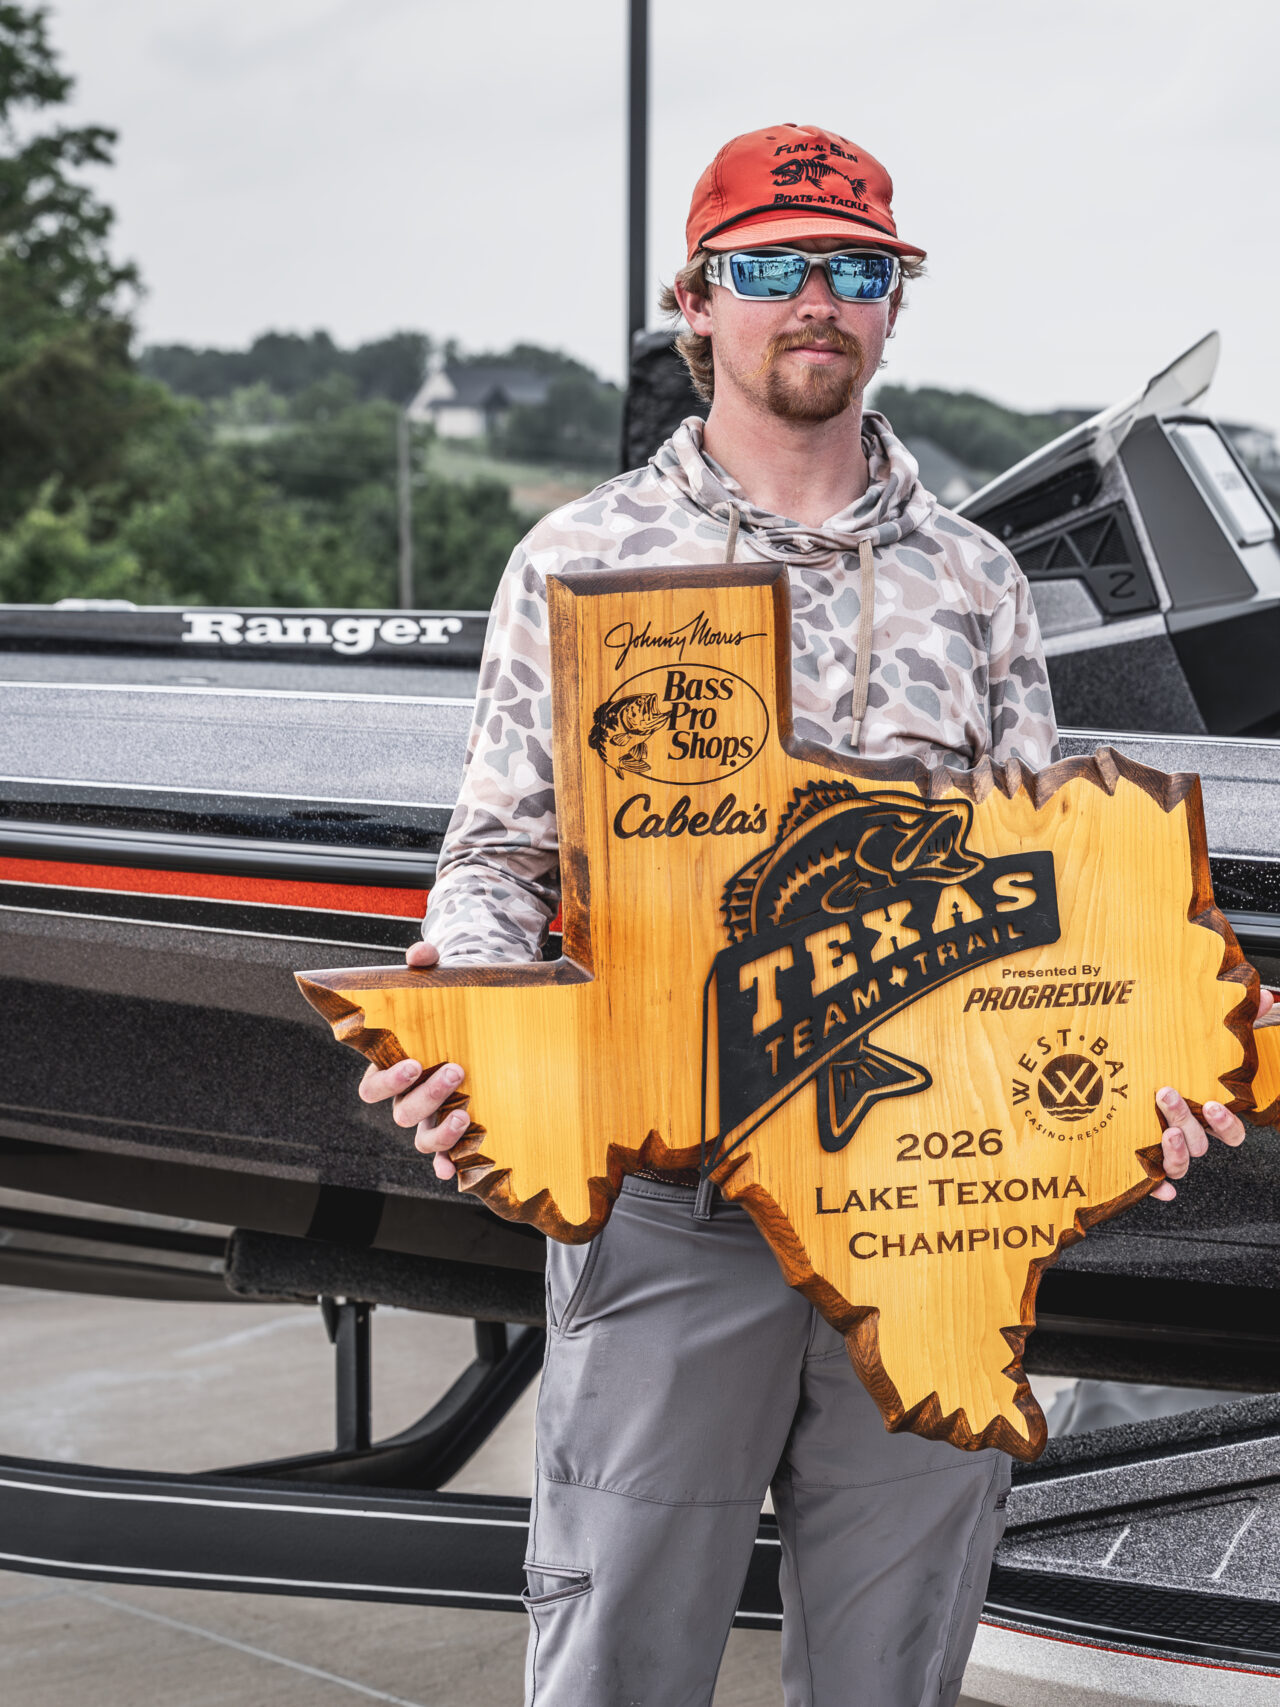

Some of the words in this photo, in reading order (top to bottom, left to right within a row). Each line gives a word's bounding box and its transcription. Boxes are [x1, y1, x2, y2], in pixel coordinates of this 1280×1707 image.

[182, 613, 463, 655] Ranger
[604, 621, 687, 671] Johnny
[663, 670, 734, 701] Bass
[667, 702, 717, 731] Pro
[613, 793, 768, 839] Cabela's
[739, 872, 1038, 1036] TEXAS
[1001, 966, 1077, 979] Presented
[1081, 964, 1101, 978] By
[765, 978, 880, 1076] TEAM
[913, 922, 1026, 976] TRAIL
[963, 980, 1135, 1013] PROGRESSIVE
[896, 1128, 1003, 1162] 2026
[815, 1186, 918, 1215] LAKE
[928, 1175, 1087, 1207] TEXOMA
[849, 1224, 1055, 1259] CHAMPION
